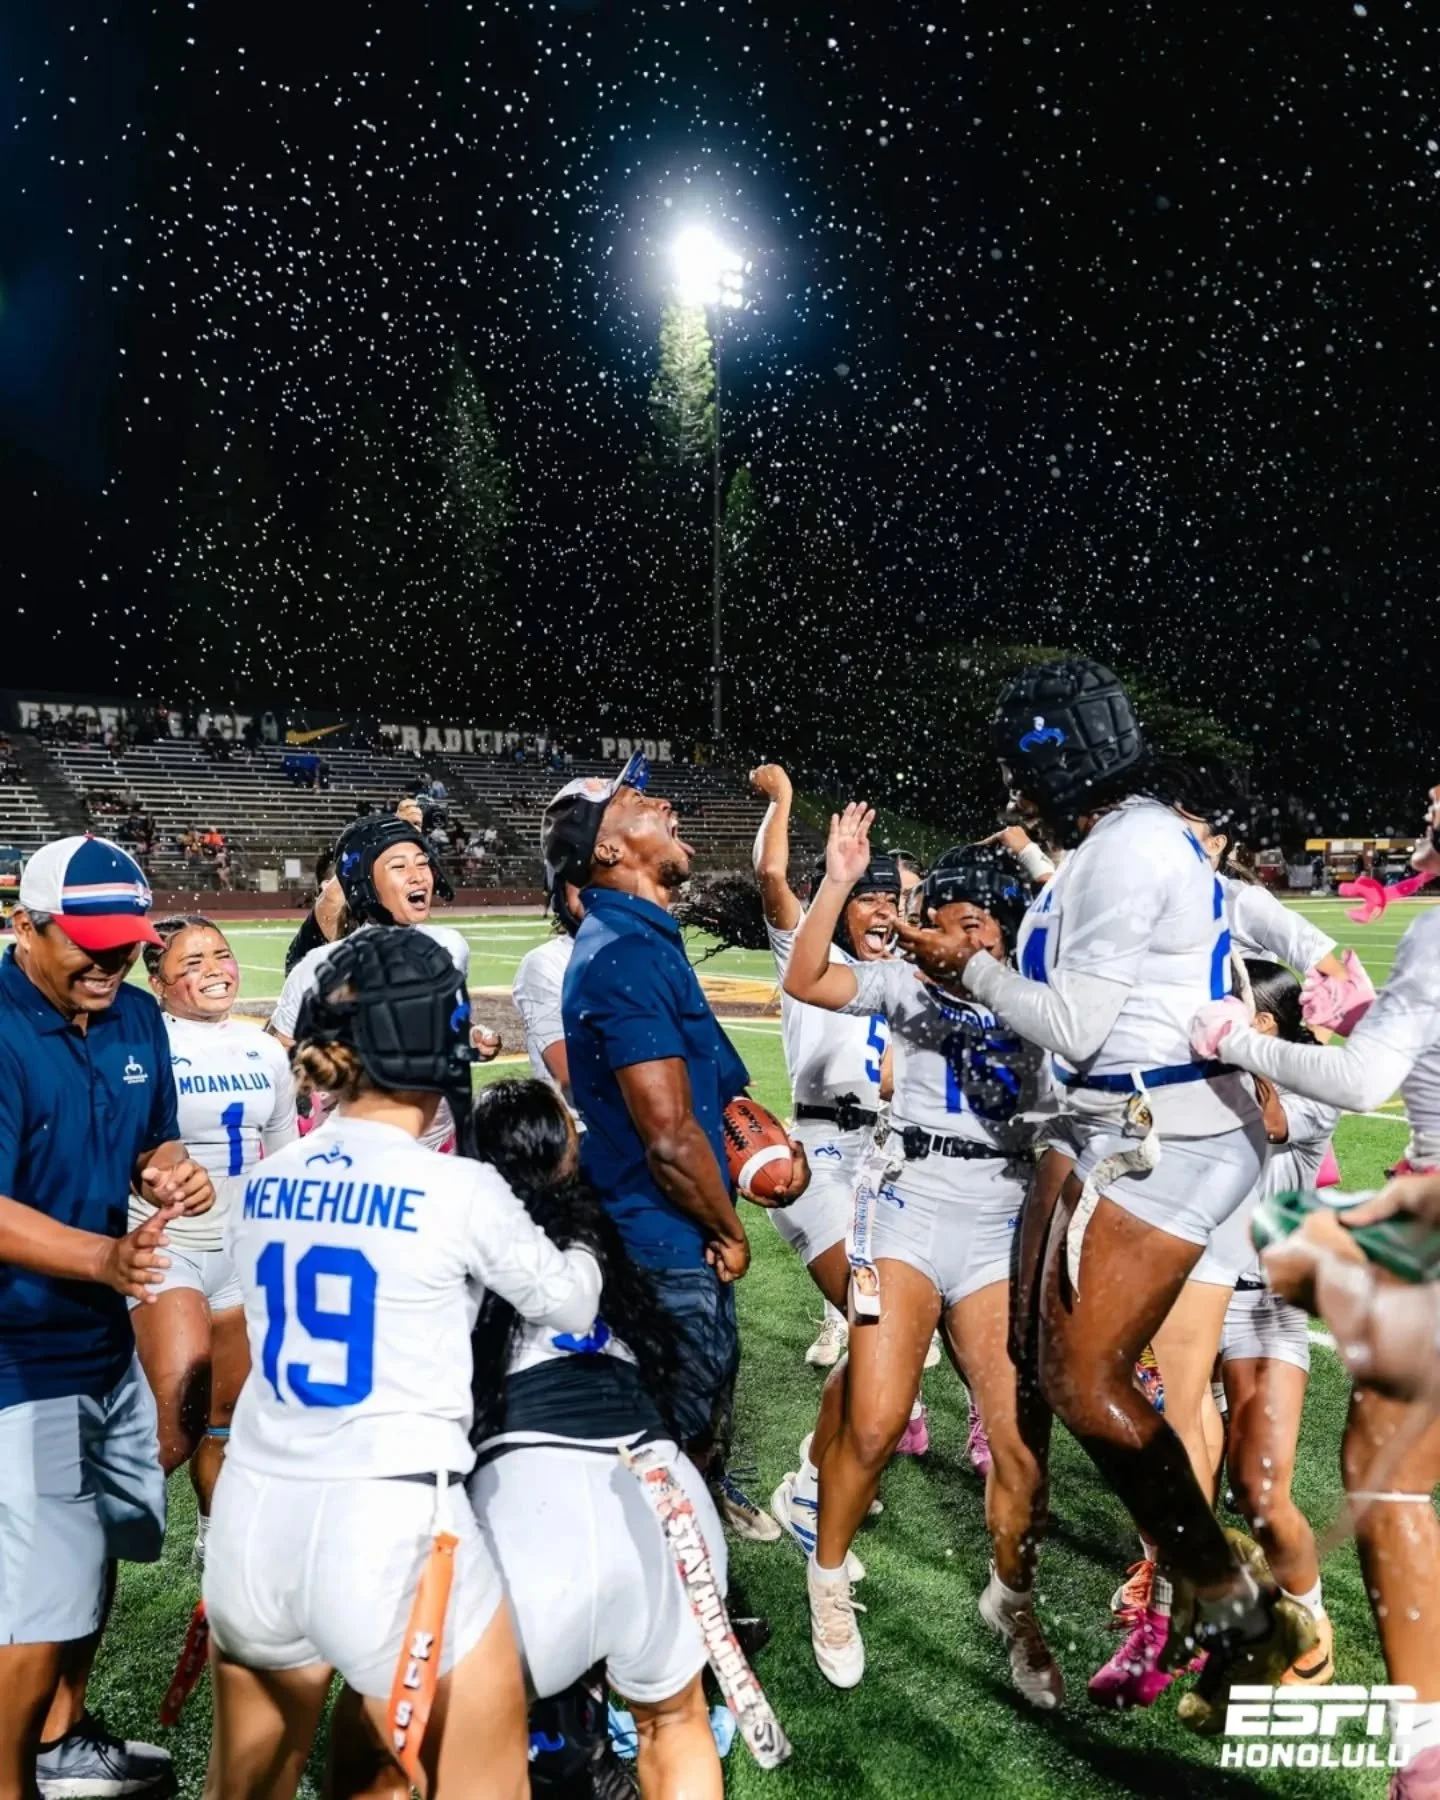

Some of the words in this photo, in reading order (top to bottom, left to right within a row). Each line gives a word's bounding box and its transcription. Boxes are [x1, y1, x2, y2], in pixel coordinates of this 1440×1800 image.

[17, 701, 253, 740] EXCEECE
[379, 724, 548, 755] TRADITIO
[602, 737, 672, 762] PRIDE
[178, 1072, 271, 1095] MOANALUA
[221, 1102, 244, 1176] 1
[243, 1177, 426, 1233] MENEHUNE
[256, 1241, 378, 1407] 19
[667, 1513, 712, 1590] STAY
[693, 1586, 757, 1714] HUMBLE
